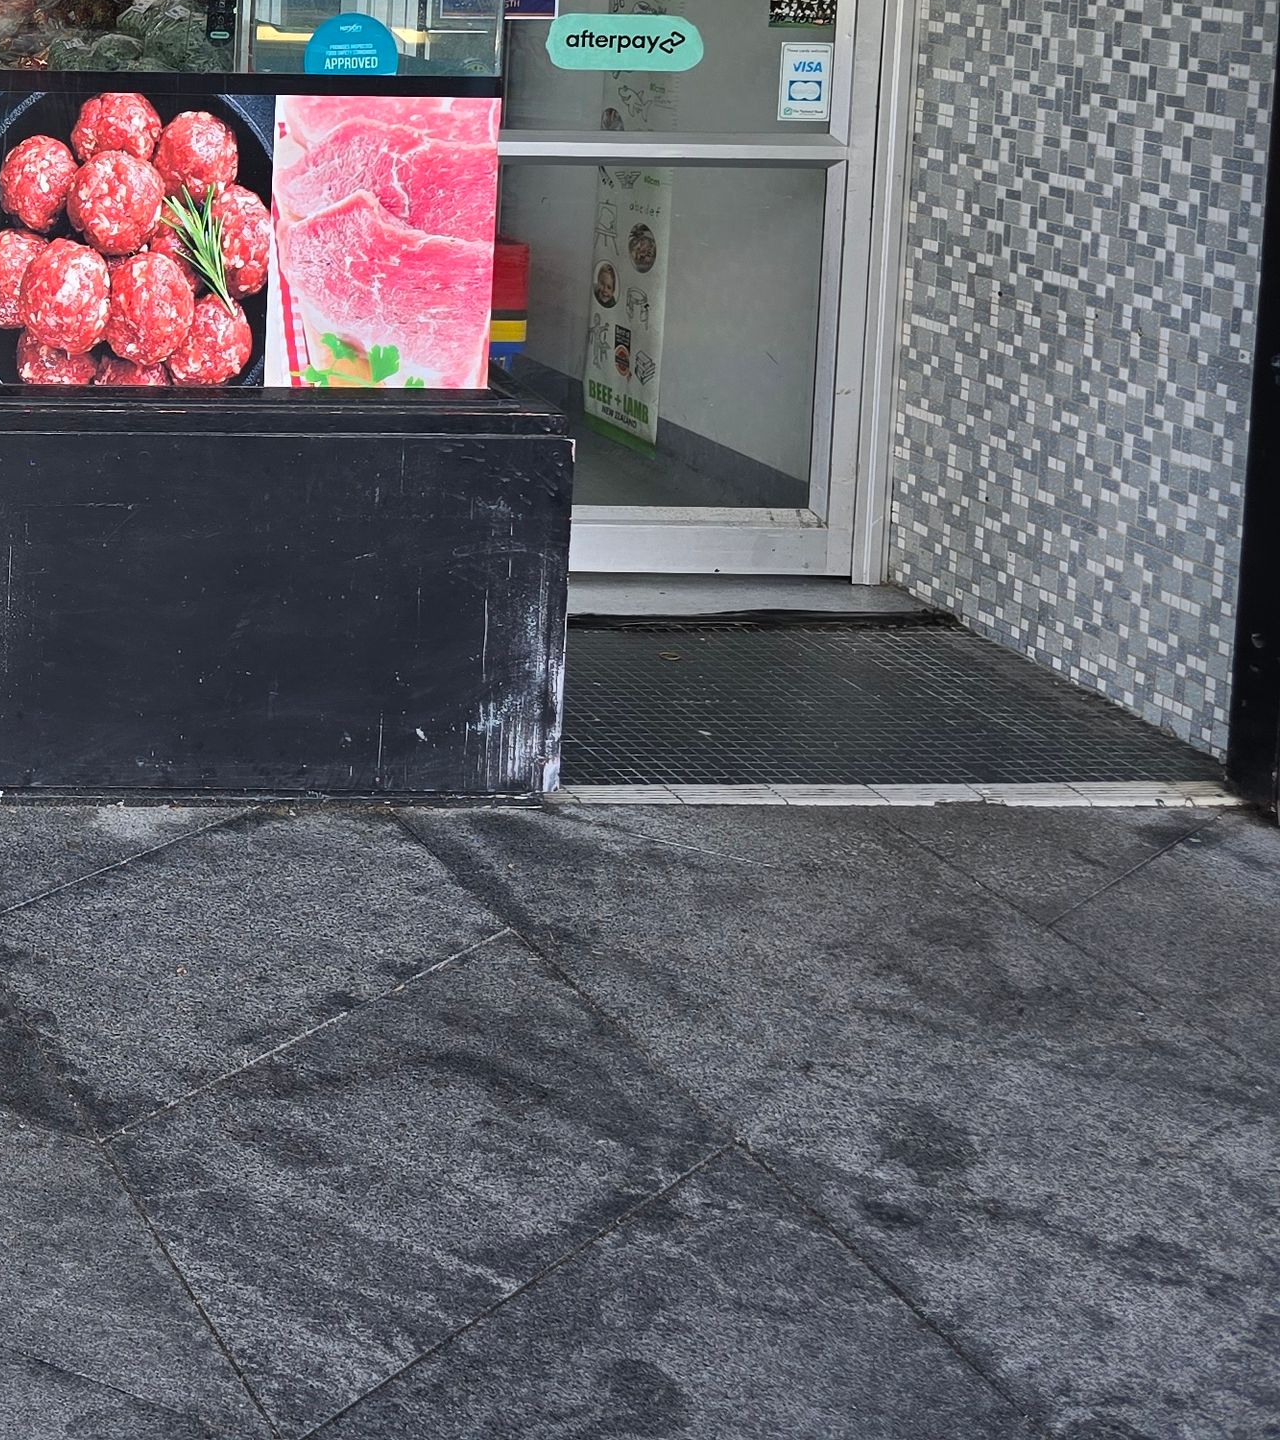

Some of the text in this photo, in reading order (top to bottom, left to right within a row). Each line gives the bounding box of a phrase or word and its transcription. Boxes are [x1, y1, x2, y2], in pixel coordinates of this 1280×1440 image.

[566, 30, 660, 53] afterpay
[324, 57, 378, 70] APPROVED
[793, 61, 823, 72] VISA
[589, 379, 612, 405] BEEF
[623, 394, 648, 424] LAMB
[602, 405, 637, 428] NEW ZEALAND
